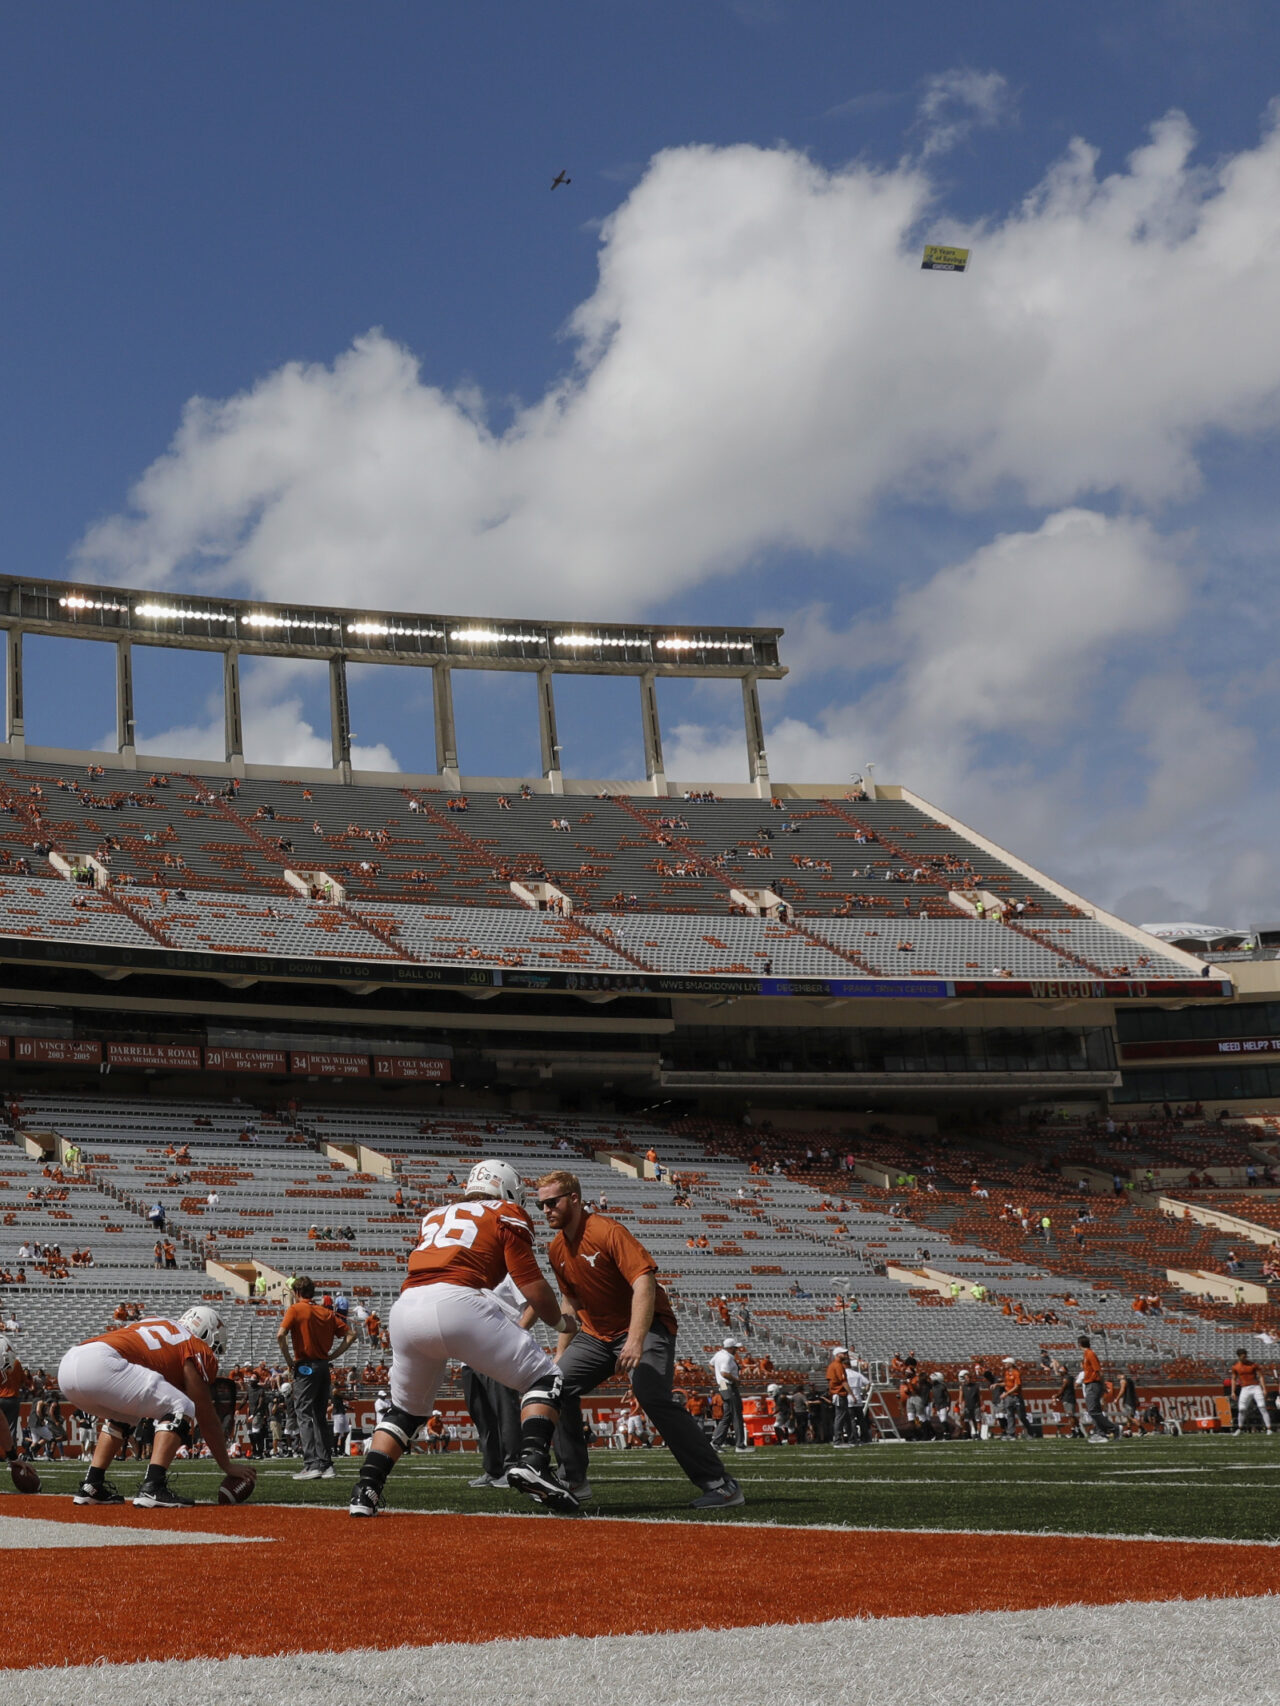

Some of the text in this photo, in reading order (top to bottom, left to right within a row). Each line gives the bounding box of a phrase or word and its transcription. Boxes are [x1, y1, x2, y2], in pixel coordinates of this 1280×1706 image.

[288, 963, 323, 974] DOWN
[338, 966, 371, 977] TO GO
[398, 968, 441, 980] BALL ON
[658, 979, 763, 992] WWE SMACKDOWN LIVE
[776, 983, 823, 993] DECEMBER
[905, 984, 939, 993] CENTER
[19, 1043, 32, 1055] 10
[39, 1041, 66, 1051] VINCE
[1218, 1041, 1241, 1052] NEED
[1242, 1040, 1269, 1051] HELP?
[48, 1051, 64, 1060] 2003
[73, 1052, 90, 1061] 2005
[110, 1047, 198, 1058] DARRELL K ROYAL
[224, 1051, 285, 1063] EARL CAMPBELL
[132, 1056, 168, 1065] MEMORIAL
[169, 1058, 199, 1066] STADIUM
[207, 1052, 221, 1065] 20
[293, 1057, 307, 1069] 34
[310, 1055, 368, 1066] RICKY WILLIAMS
[236, 1061, 251, 1069] 1974
[259, 1062, 274, 1070] 1977
[321, 1065, 336, 1073] 1995
[344, 1065, 359, 1073] 1998
[377, 1061, 390, 1073] 12
[397, 1060, 445, 1070] COLT McCOY
[403, 1068, 418, 1077] 2005
[425, 1070, 441, 1078] 2009
[417, 1201, 486, 1251] 56
